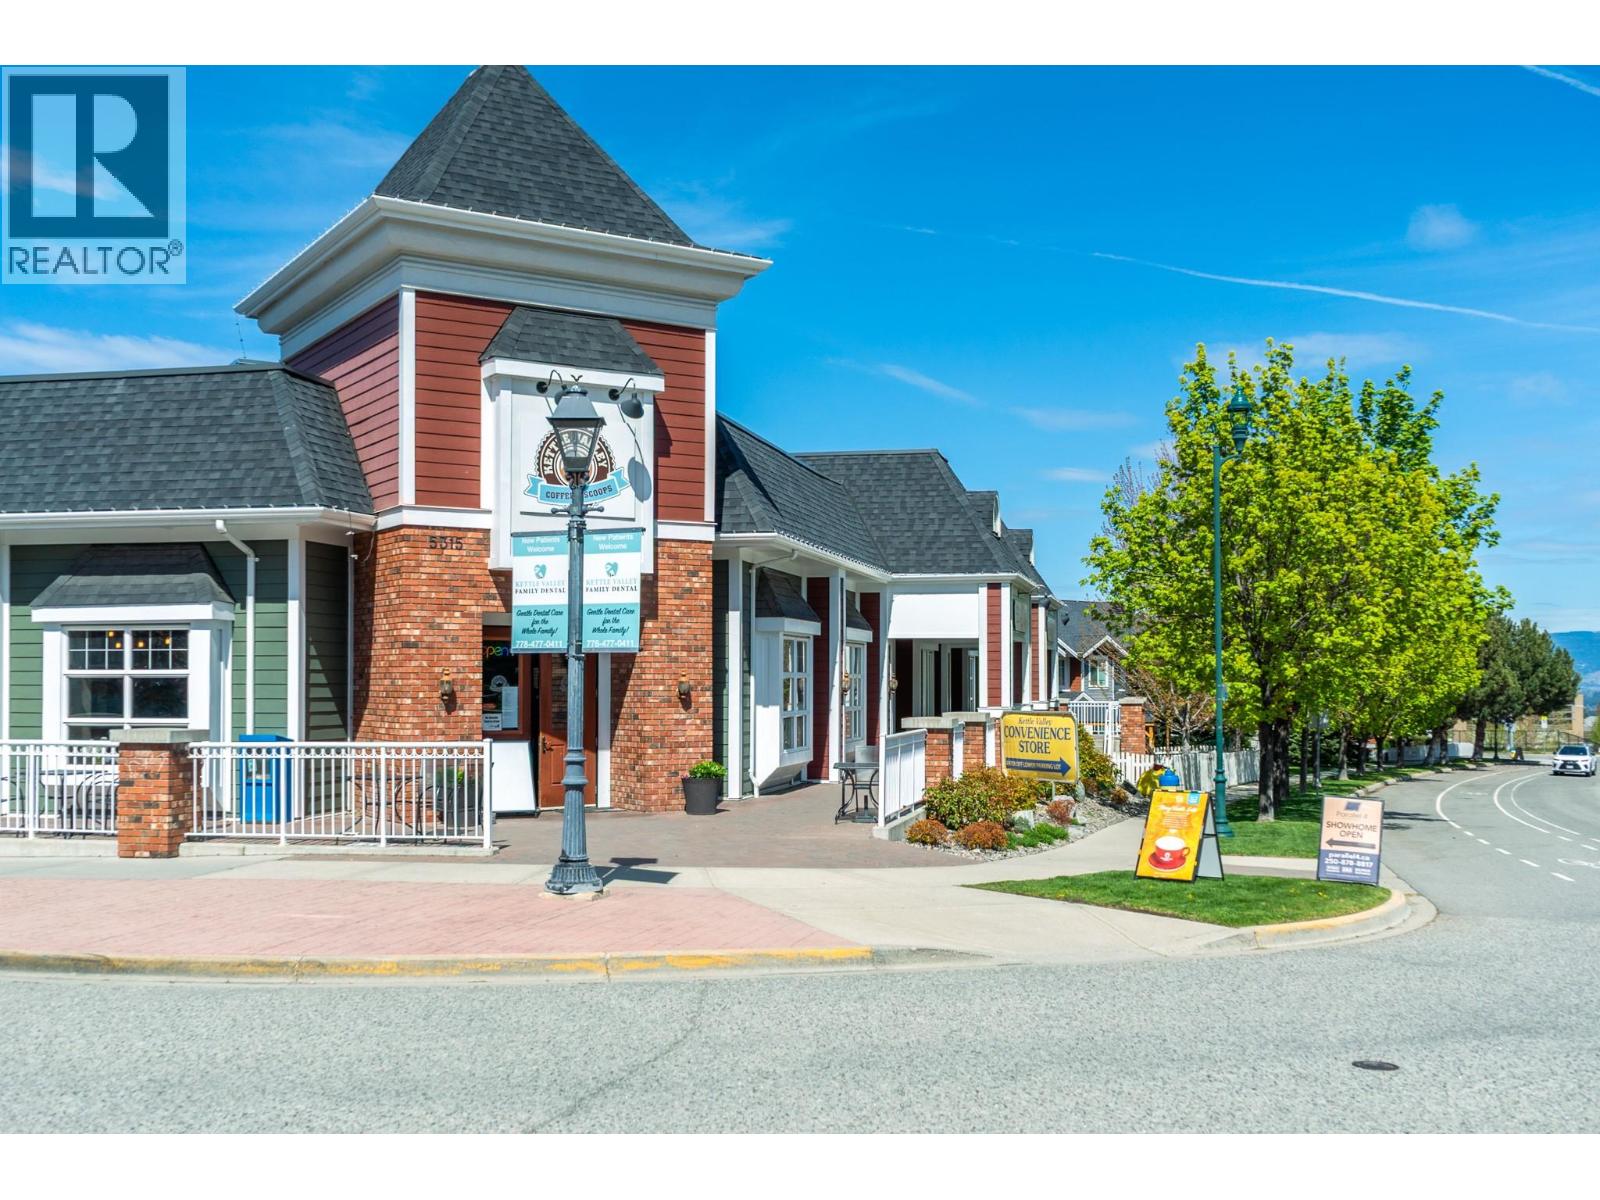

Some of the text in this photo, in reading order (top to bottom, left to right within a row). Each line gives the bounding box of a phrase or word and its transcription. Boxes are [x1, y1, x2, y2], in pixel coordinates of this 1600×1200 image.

[543, 433, 571, 475] KETTE
[546, 485, 613, 499] COFFE SCOOPS
[613, 577, 638, 585] VALLEY
[604, 607, 622, 615] Dental
[622, 607, 635, 615] Care
[531, 618, 540, 627] for
[602, 616, 620, 626] for the
[521, 627, 537, 635] Whole
[1036, 718, 1052, 726] Valley
[1004, 725, 1071, 740] CONVENIENCE
[1019, 740, 1051, 754] STORE
[1326, 821, 1377, 833] SHOWHOME
[1339, 830, 1363, 839] OPEN
